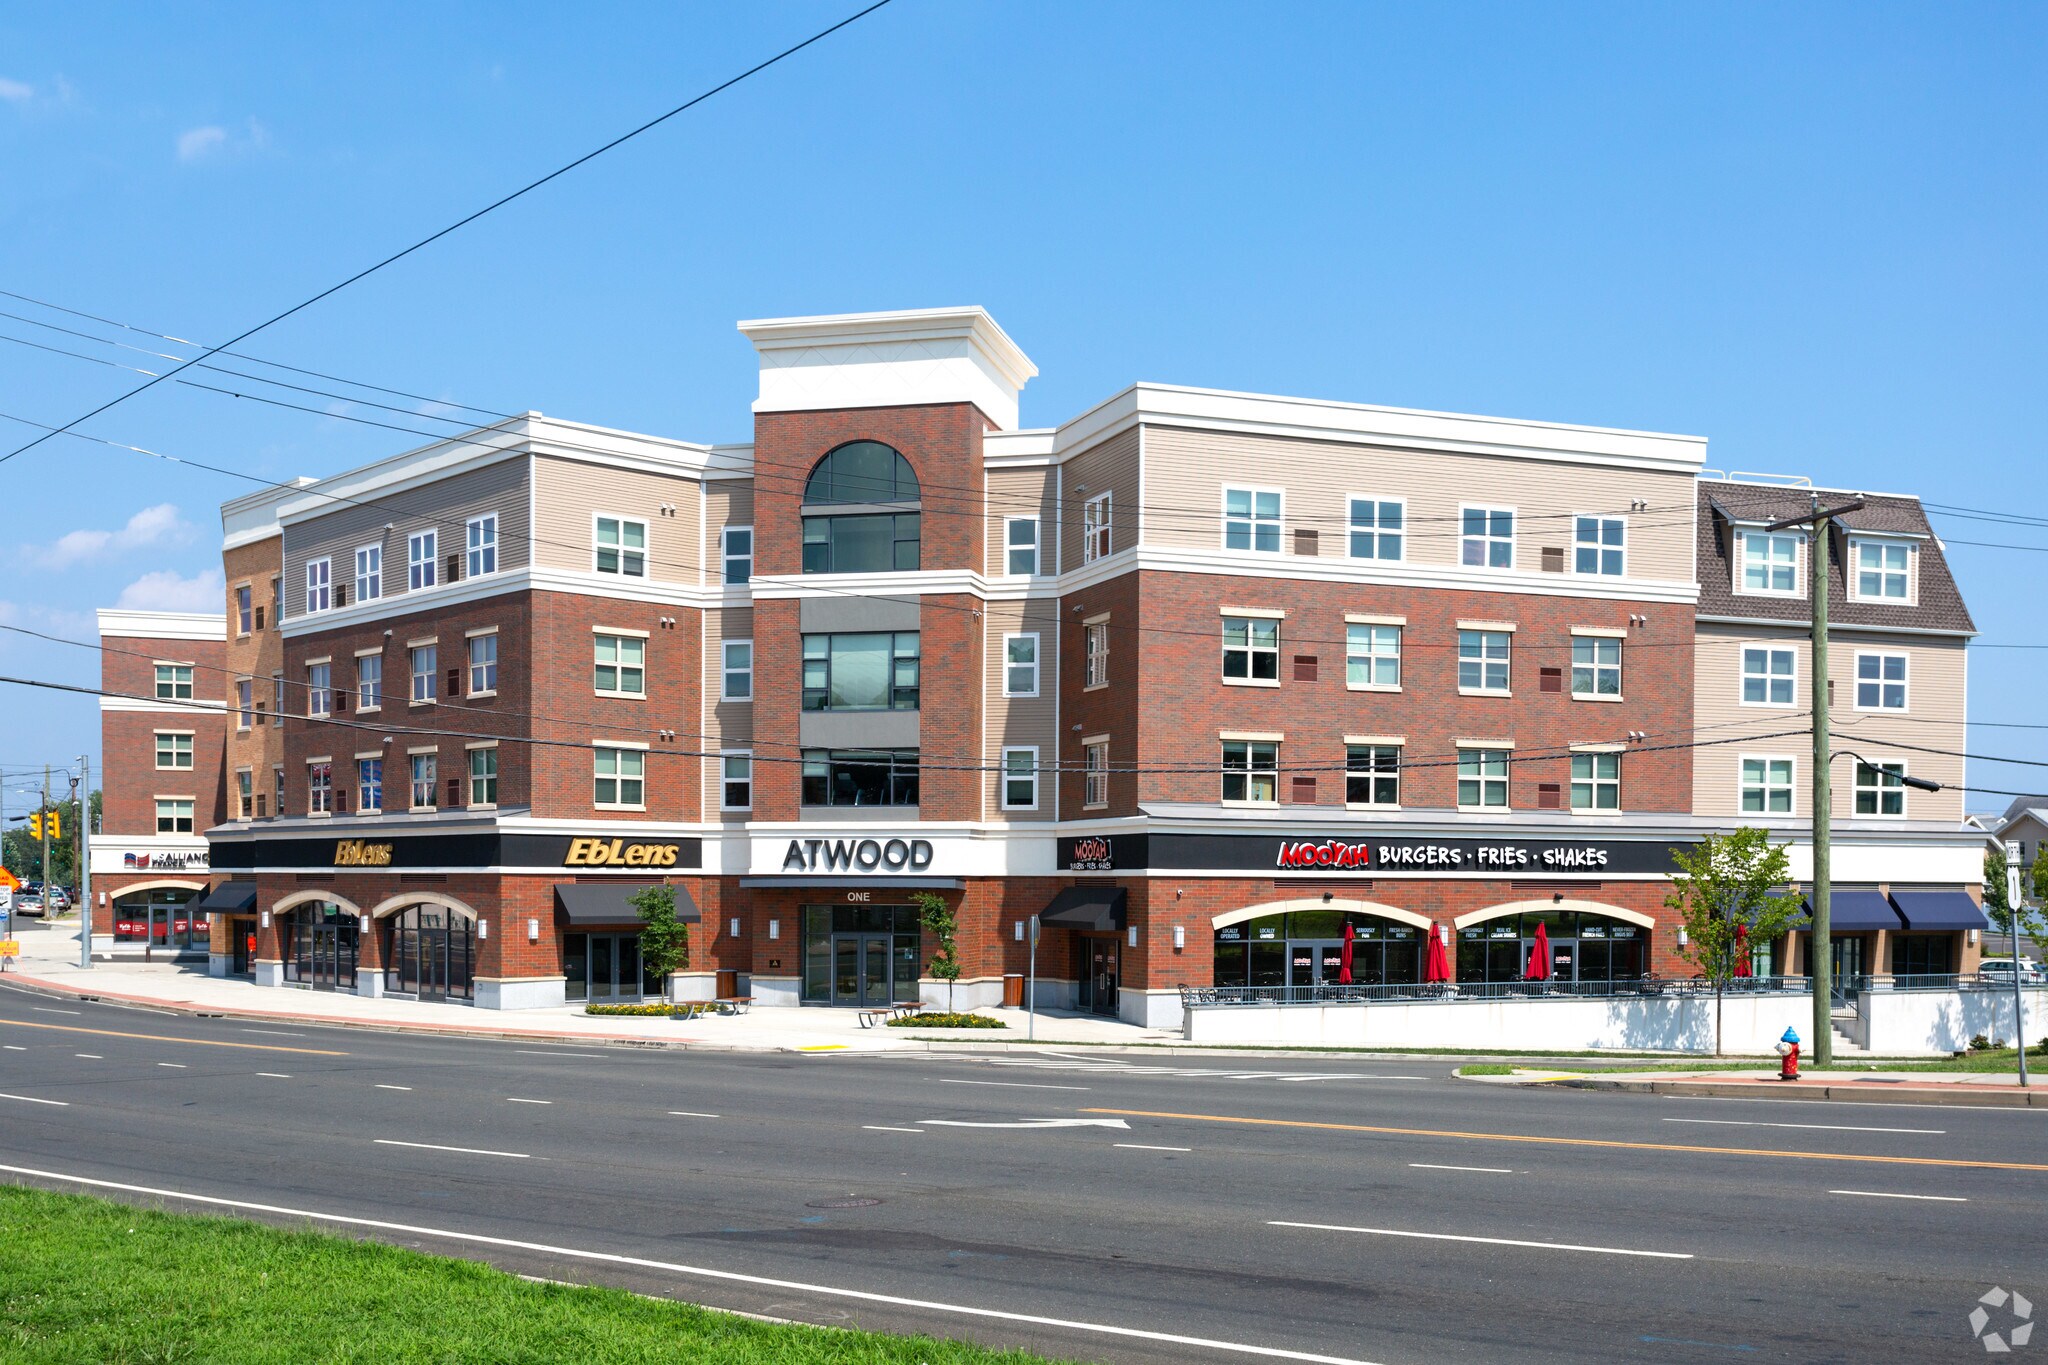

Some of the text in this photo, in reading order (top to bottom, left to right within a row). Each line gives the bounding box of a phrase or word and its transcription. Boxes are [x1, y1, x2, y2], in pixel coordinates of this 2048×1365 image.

[334, 839, 393, 865] EbLens
[564, 838, 680, 866] EbLens
[783, 838, 933, 868] ATWOOD
[1074, 837, 1111, 861] MOOYAH
[1277, 840, 1608, 867] MOOYAH BURGERS FRIES SHAKES
[847, 892, 870, 902] ONE
